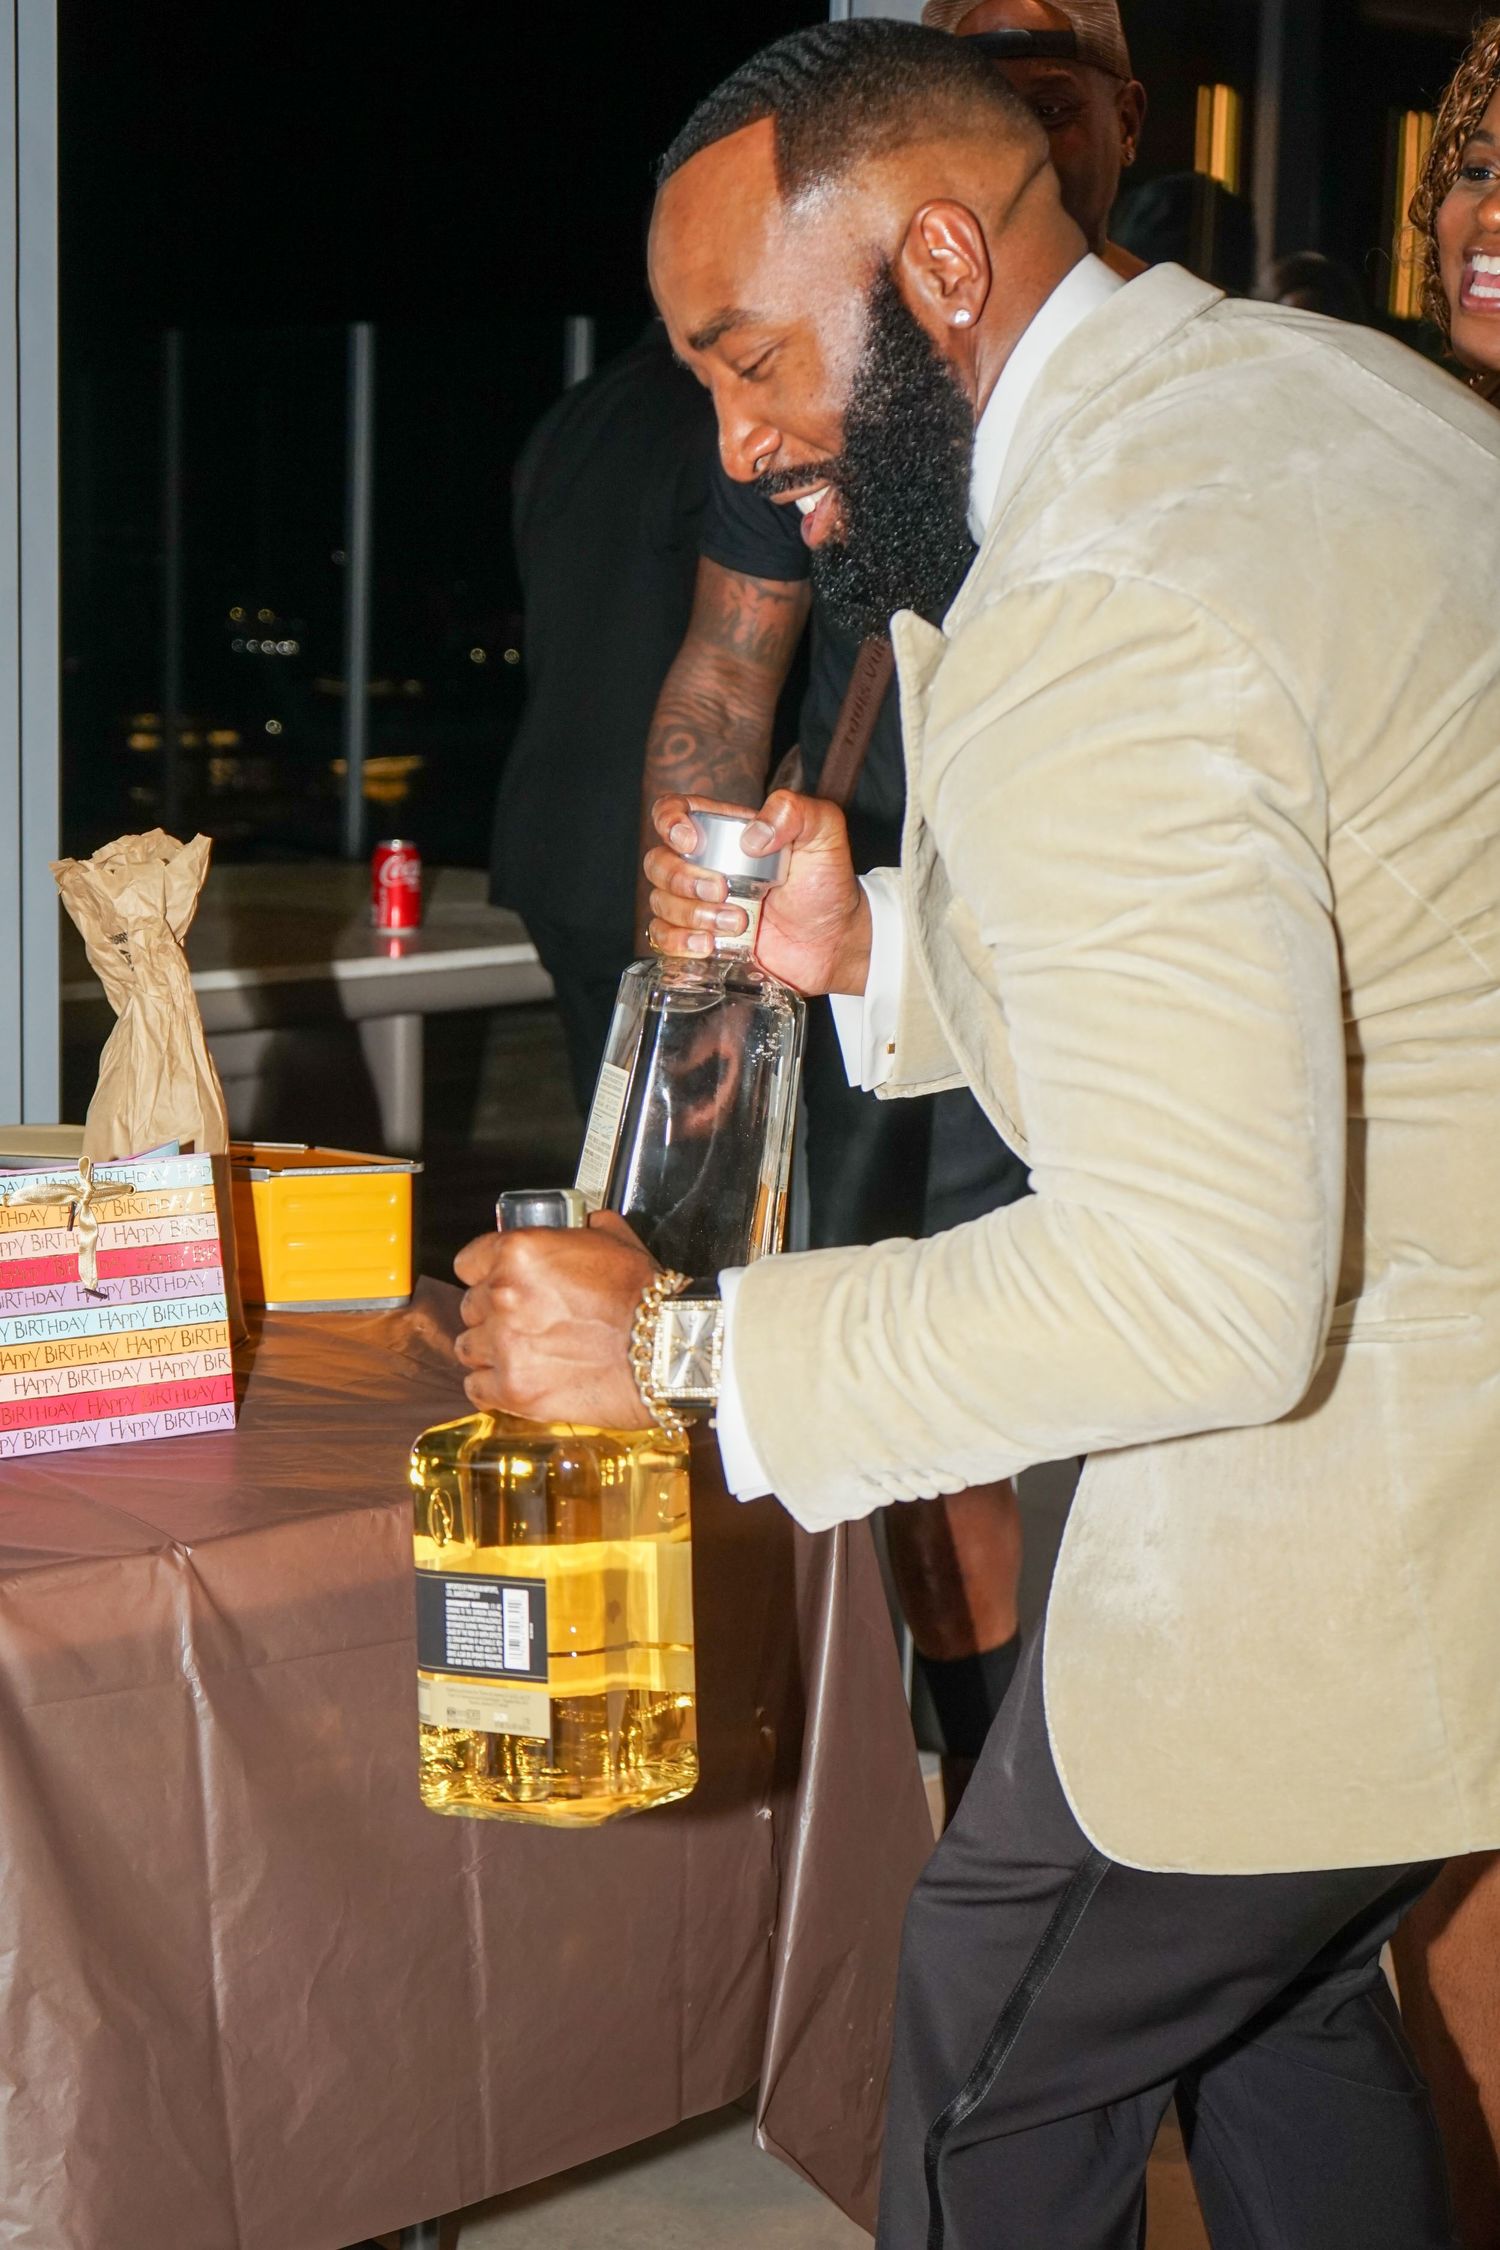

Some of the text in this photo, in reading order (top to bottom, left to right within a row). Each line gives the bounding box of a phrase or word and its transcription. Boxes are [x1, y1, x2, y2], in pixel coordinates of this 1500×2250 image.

[113, 1224, 165, 1245] HAPPY
[0, 1285, 66, 1309] IRTHDAY
[75, 1279, 126, 1303] HPPY
[129, 1271, 208, 1297] BIRTHDAY
[14, 1313, 89, 1339] BIRTHDAY
[98, 1306, 149, 1331] HAPPY
[45, 1338, 119, 1364] BIRTHDAY
[126, 1331, 177, 1355] HAPPY
[181, 1326, 227, 1348] BIRTH
[14, 1372, 63, 1396] HAPPY
[67, 1362, 142, 1388] BIRTHDAY
[149, 1355, 199, 1379] HAPPY
[2, 1399, 77, 1426] BIRTHDAY
[88, 1391, 137, 1415] HAPPY
[23, 1423, 100, 1450] BIRTHDAY
[110, 1415, 160, 1440] HAPPY
